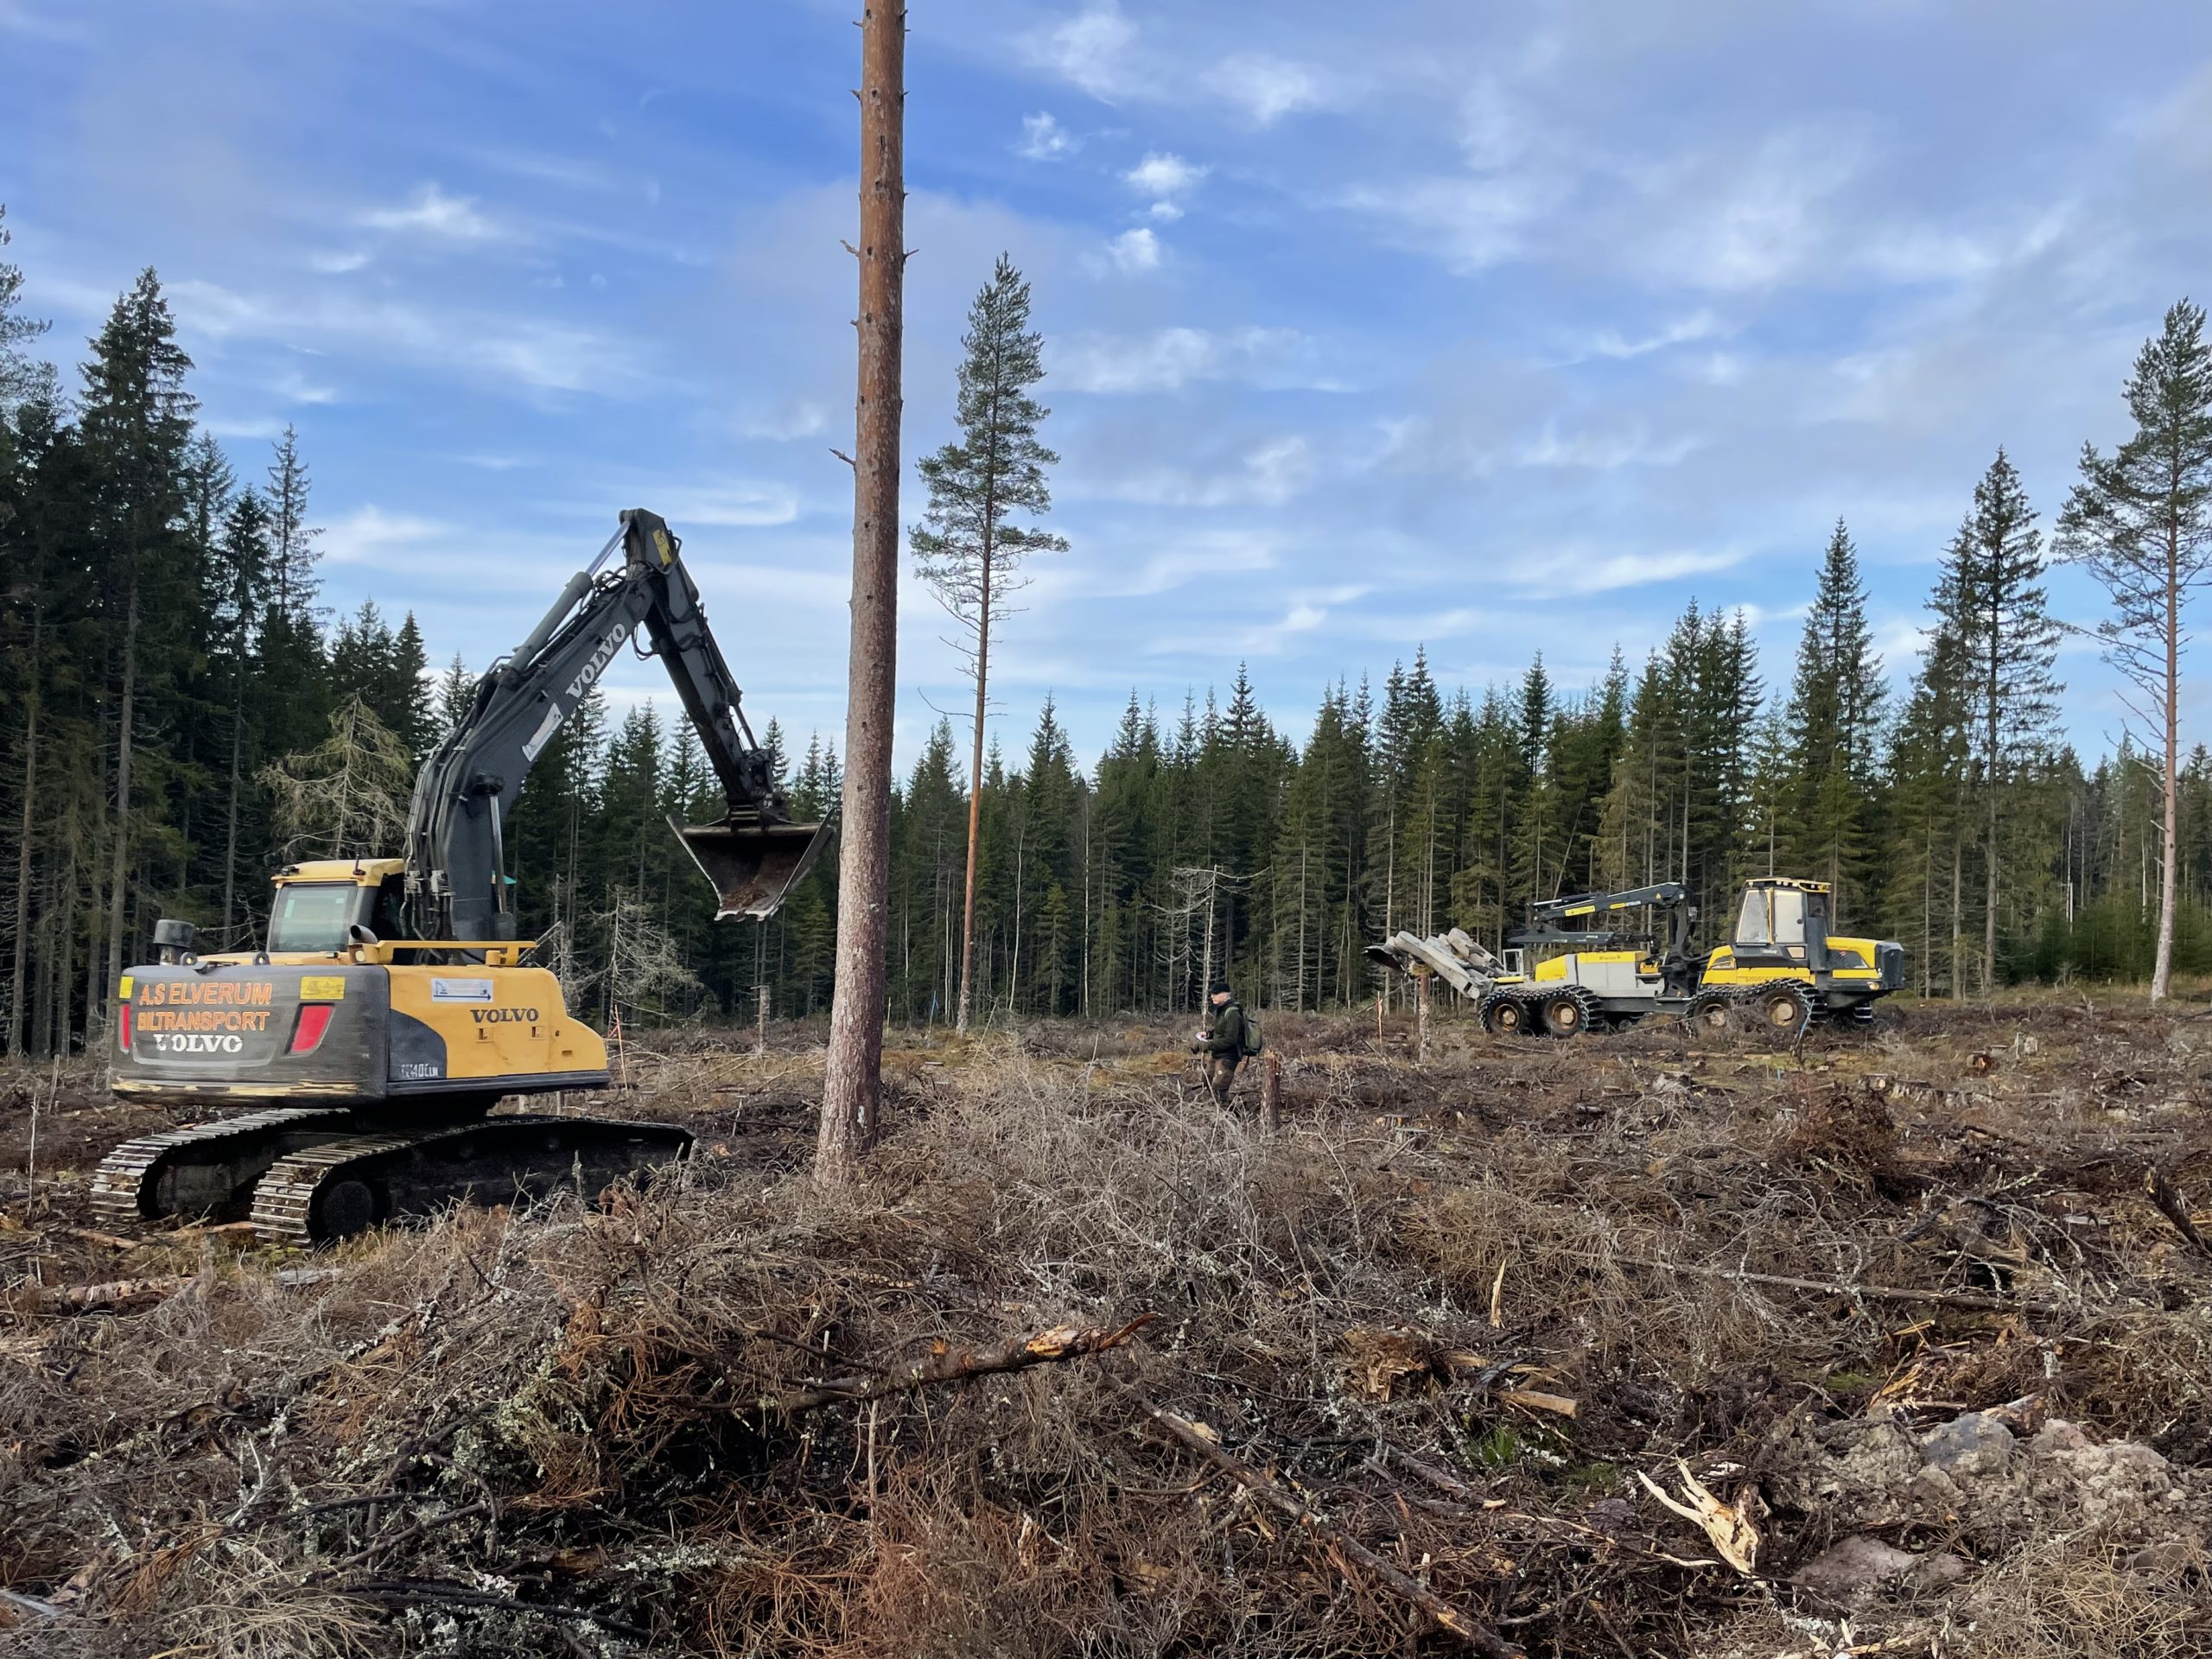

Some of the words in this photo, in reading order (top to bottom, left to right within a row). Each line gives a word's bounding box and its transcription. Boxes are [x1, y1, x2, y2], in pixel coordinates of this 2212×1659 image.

[566, 623, 626, 698] VOLVO
[168, 982, 273, 1005] ELVERUM
[137, 1011, 270, 1032] BILTRANSPORT
[470, 1007, 539, 1023] VOLVO
[153, 1033, 244, 1053] VOLVO
